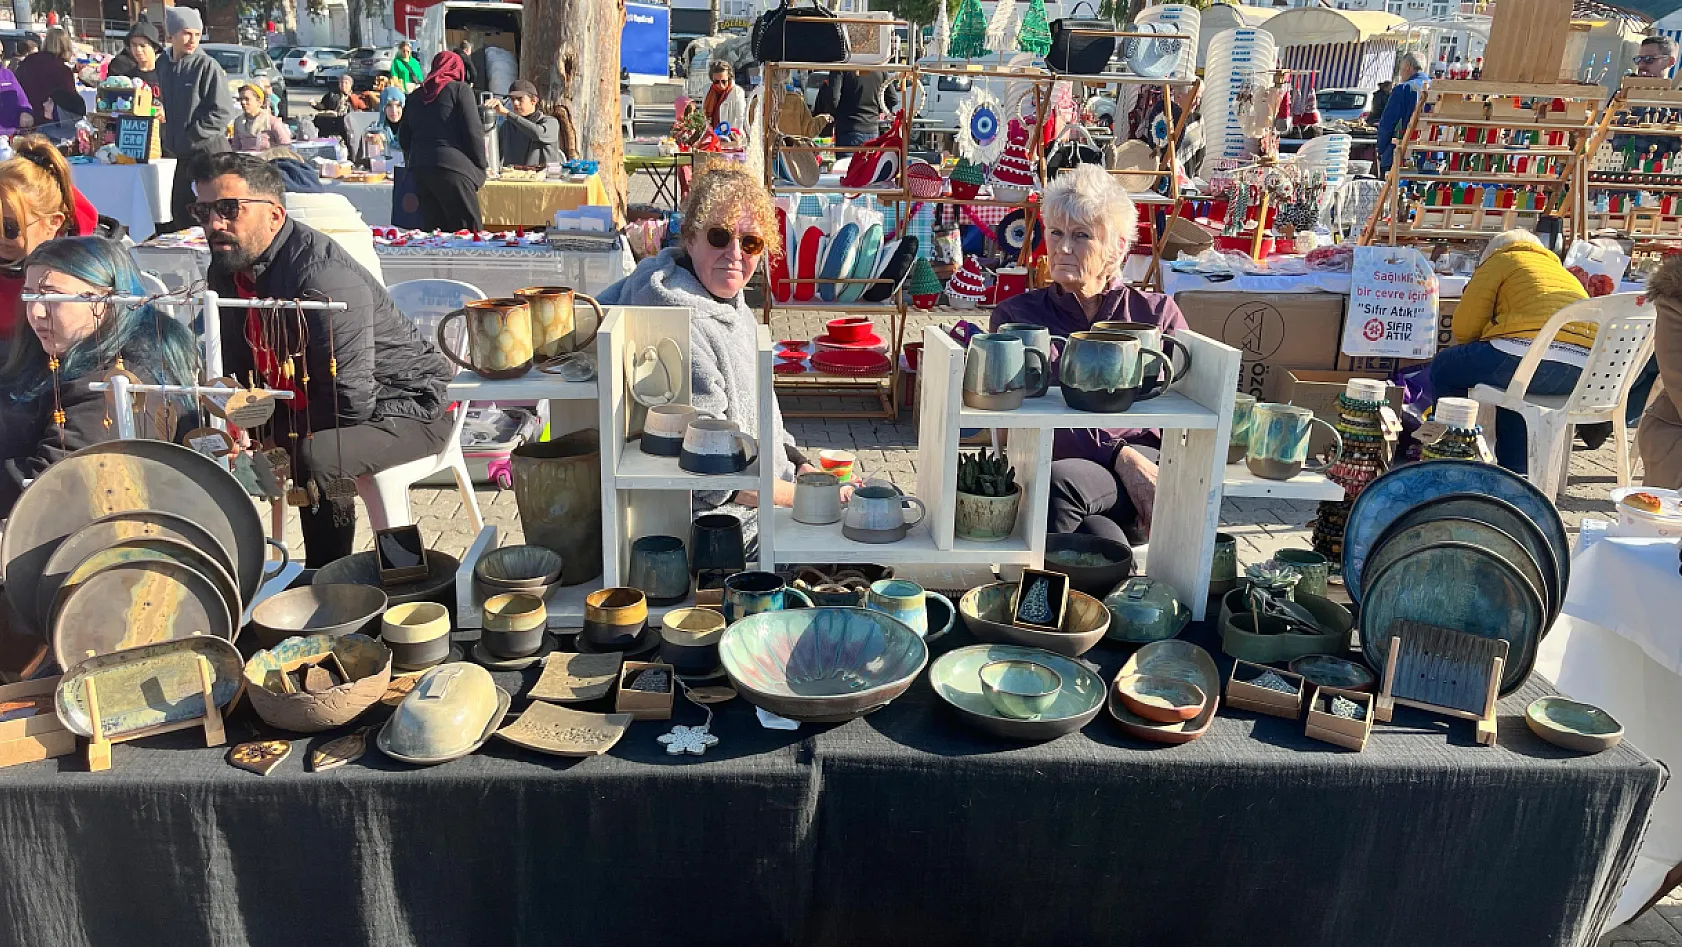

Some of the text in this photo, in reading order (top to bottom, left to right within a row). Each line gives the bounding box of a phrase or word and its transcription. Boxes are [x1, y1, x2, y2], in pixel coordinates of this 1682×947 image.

[121, 119, 147, 130] MAC
[124, 134, 143, 145] CRO
[1357, 286, 1428, 303] bir çevre için
[1386, 321, 1413, 332] SIFIR
[1386, 331, 1412, 341] ATIK
